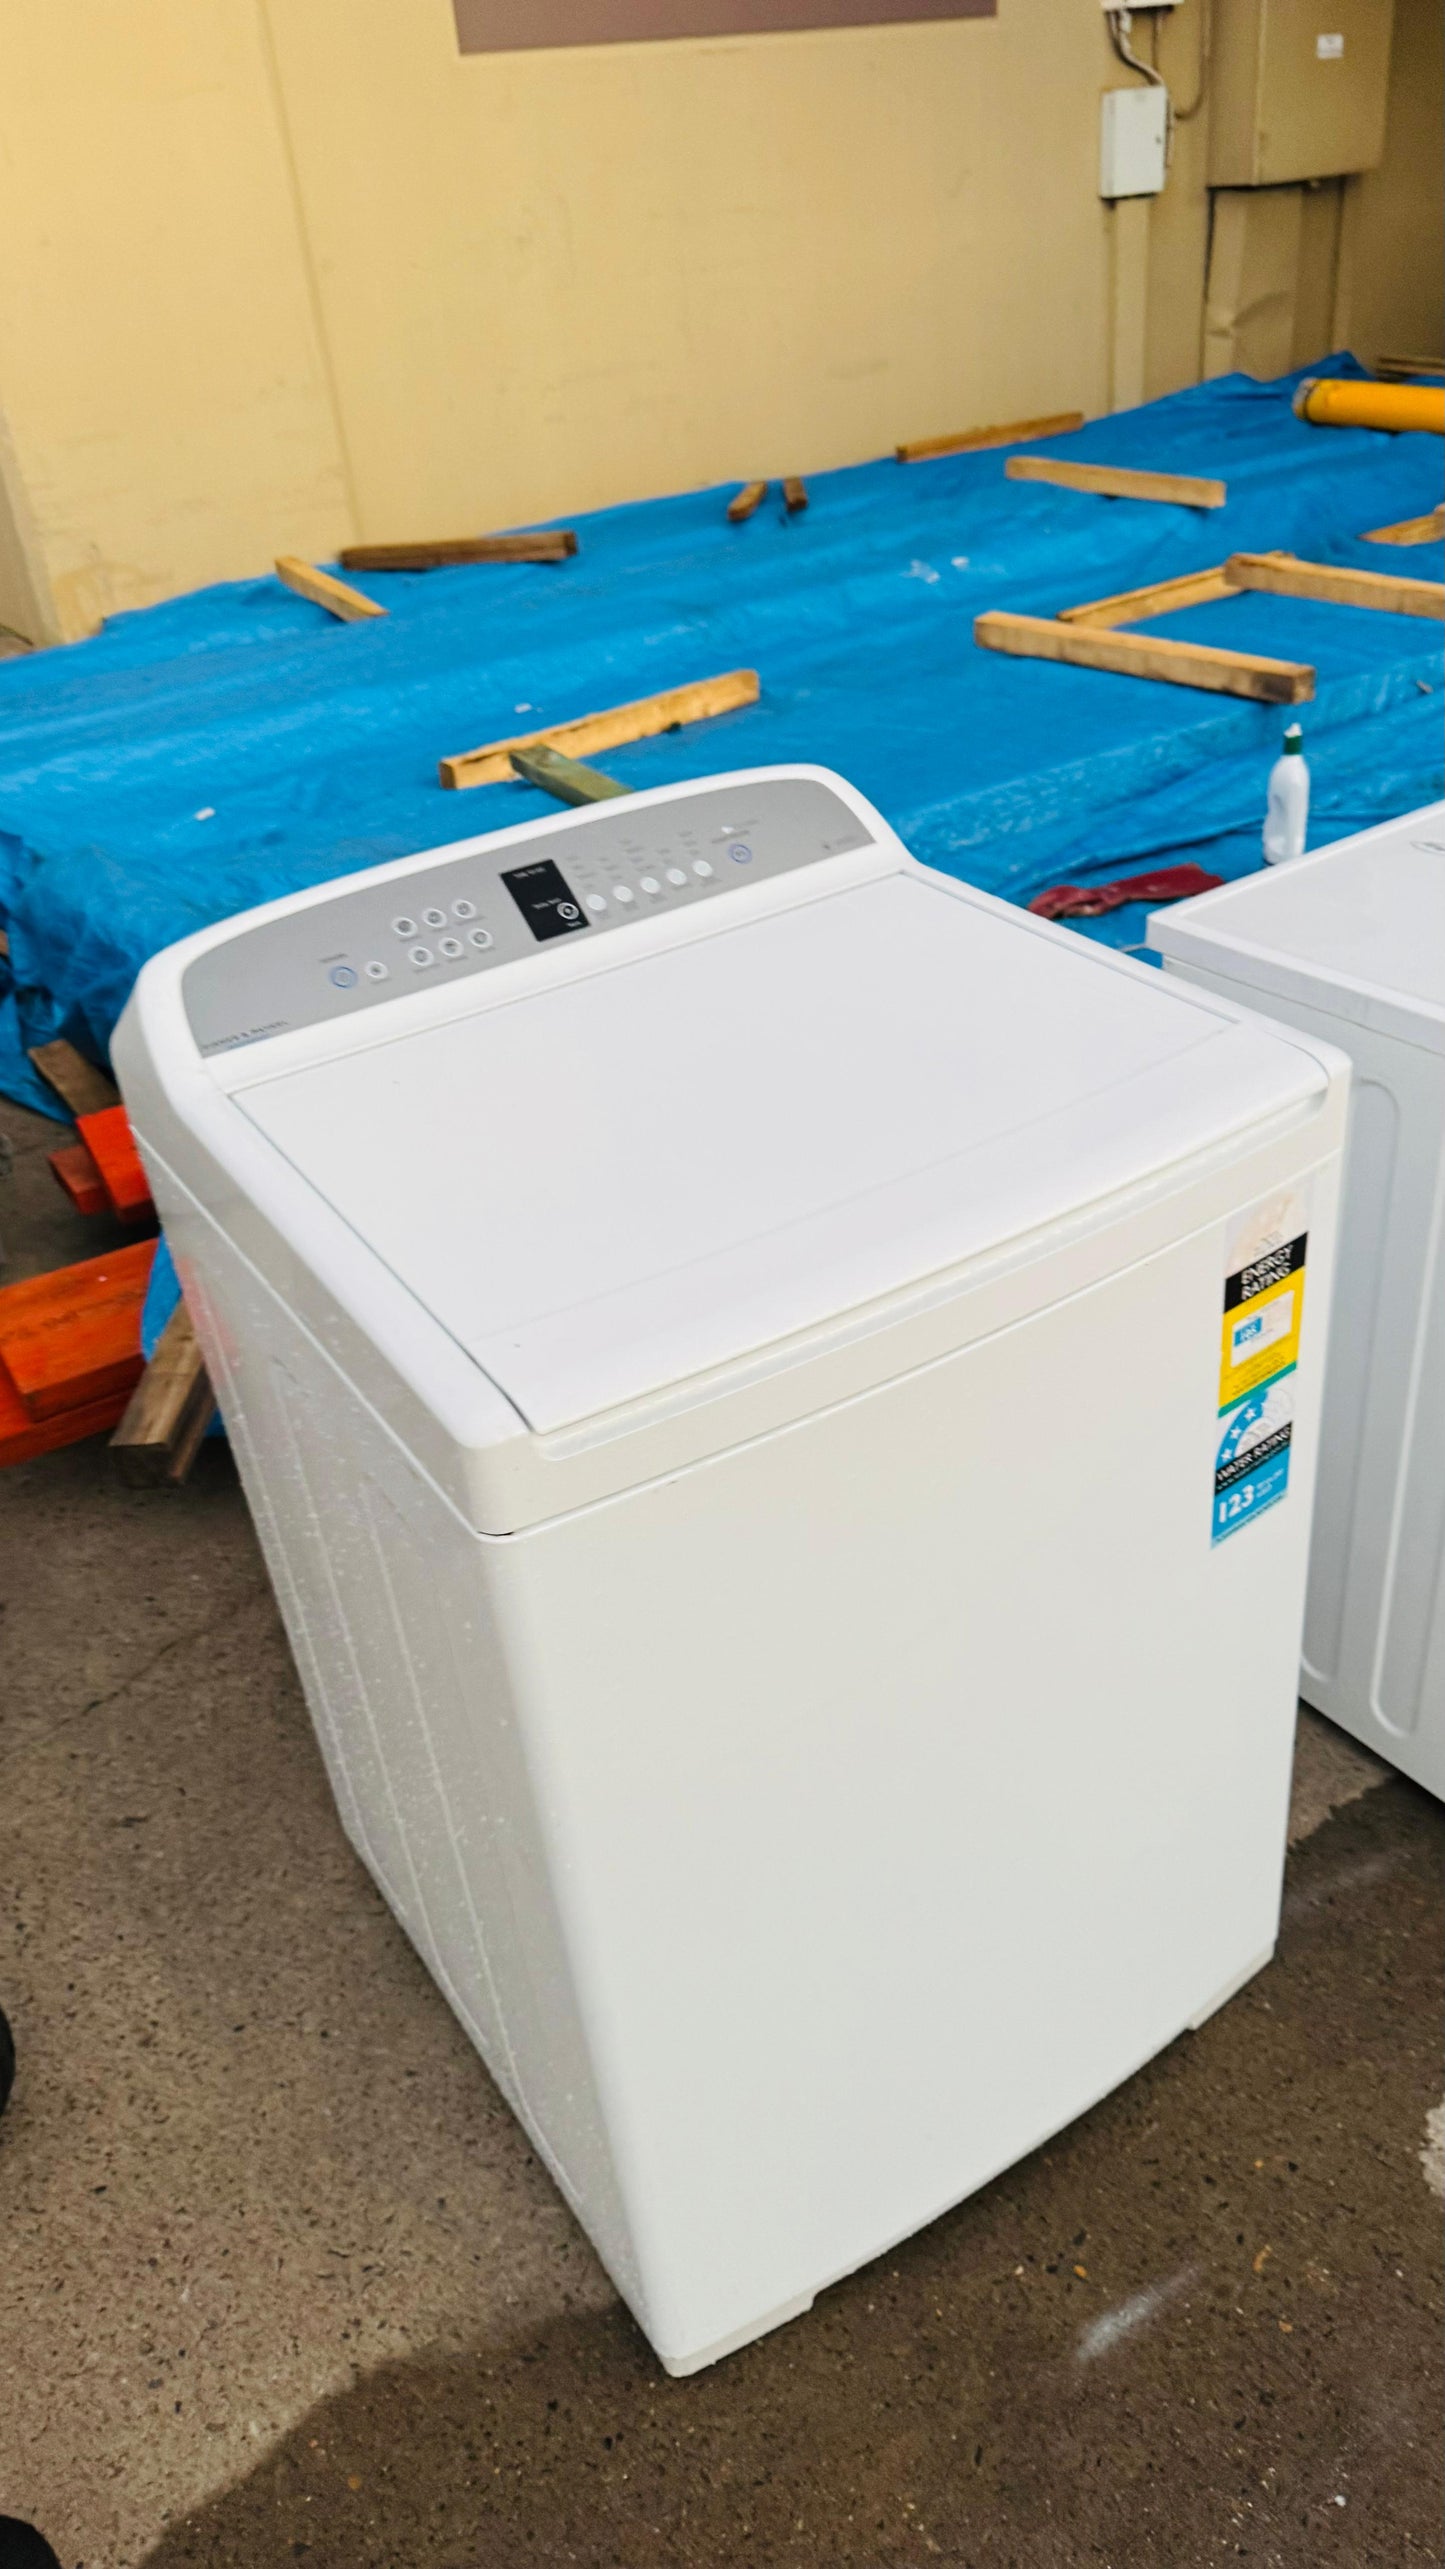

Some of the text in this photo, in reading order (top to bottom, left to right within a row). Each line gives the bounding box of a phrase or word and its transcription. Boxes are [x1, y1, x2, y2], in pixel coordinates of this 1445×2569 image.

[1241, 1244, 1293, 1285] ENERGY
[1241, 1262, 1291, 1300] RATING
[1216, 1452, 1252, 1481] WATER
[1253, 1426, 1290, 1457] RATING
[1218, 1484, 1255, 1524] 123
